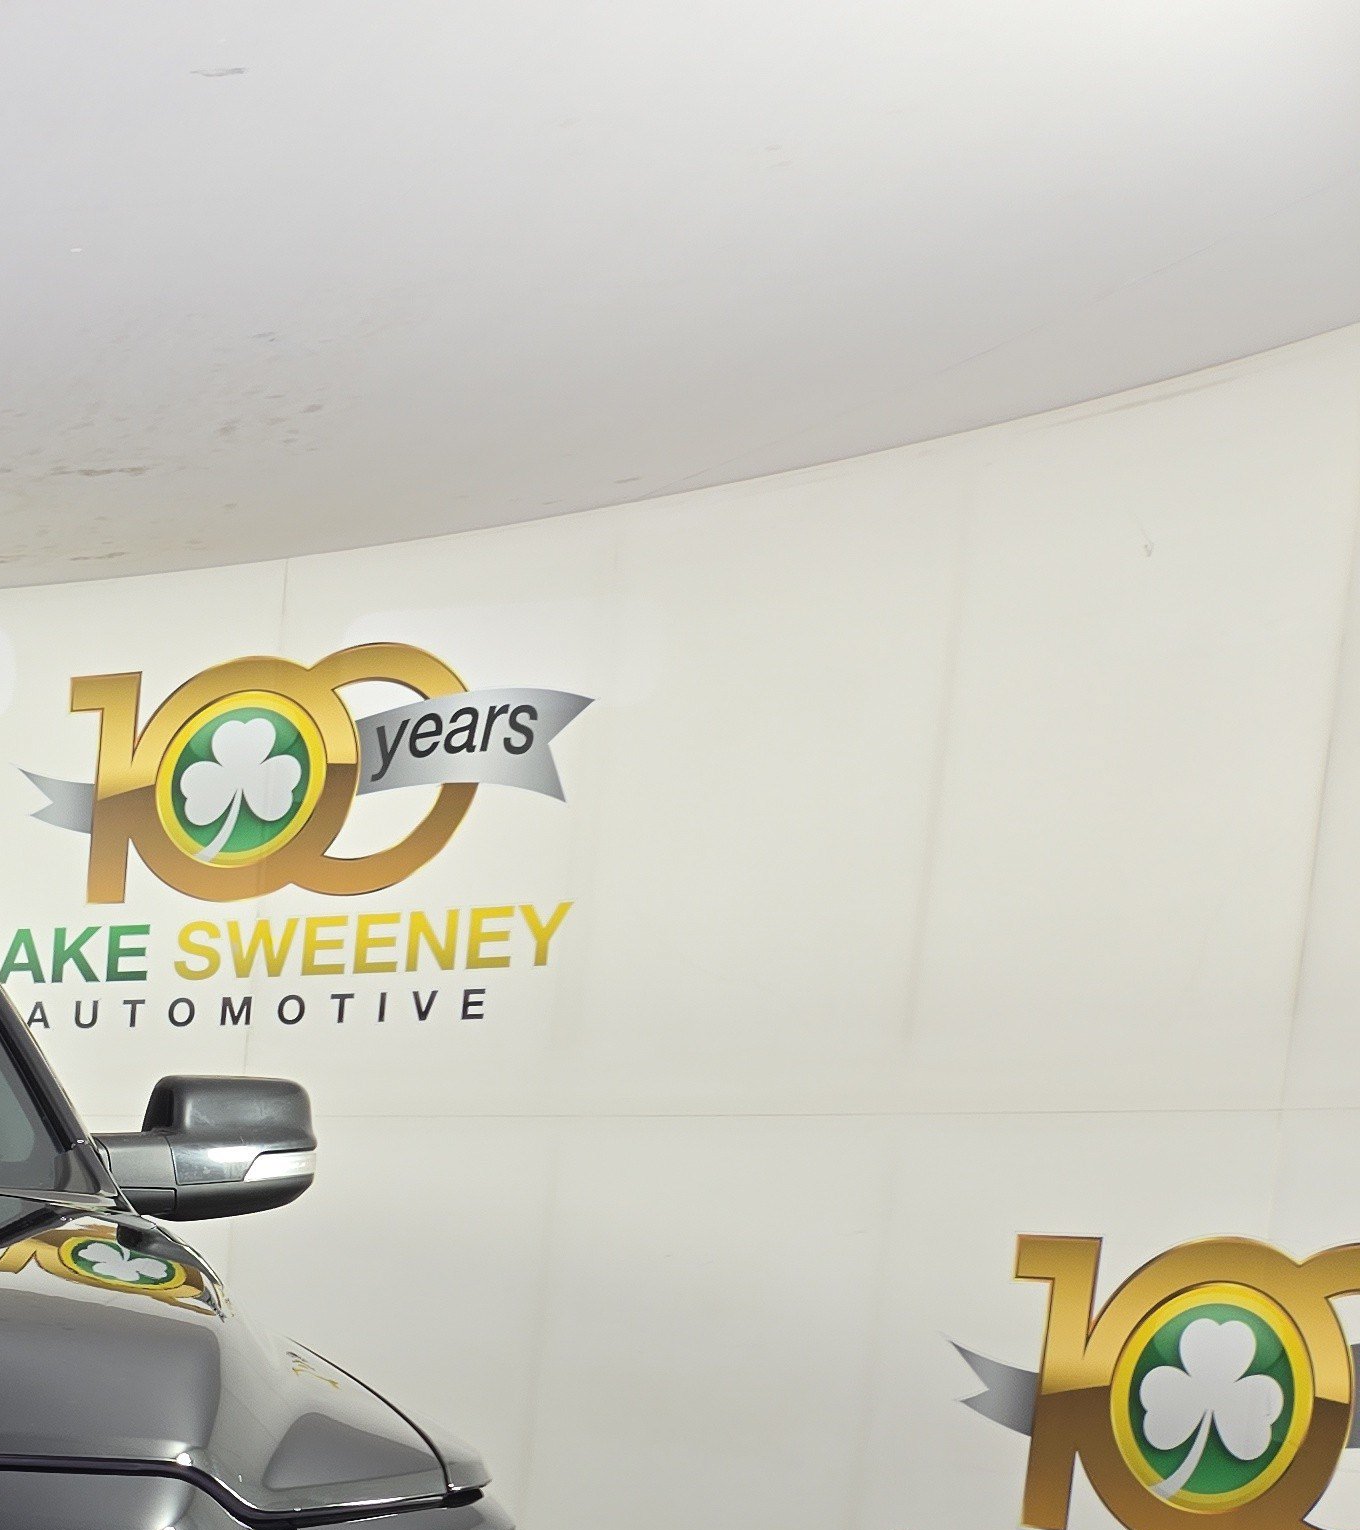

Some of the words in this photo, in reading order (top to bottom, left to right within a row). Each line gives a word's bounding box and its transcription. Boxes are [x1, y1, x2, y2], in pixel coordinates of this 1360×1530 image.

[70, 642, 479, 904] 100
[371, 704, 538, 782] years
[173, 901, 574, 980] SWEENEY
[26, 988, 487, 1030] AUTOMOTIVE
